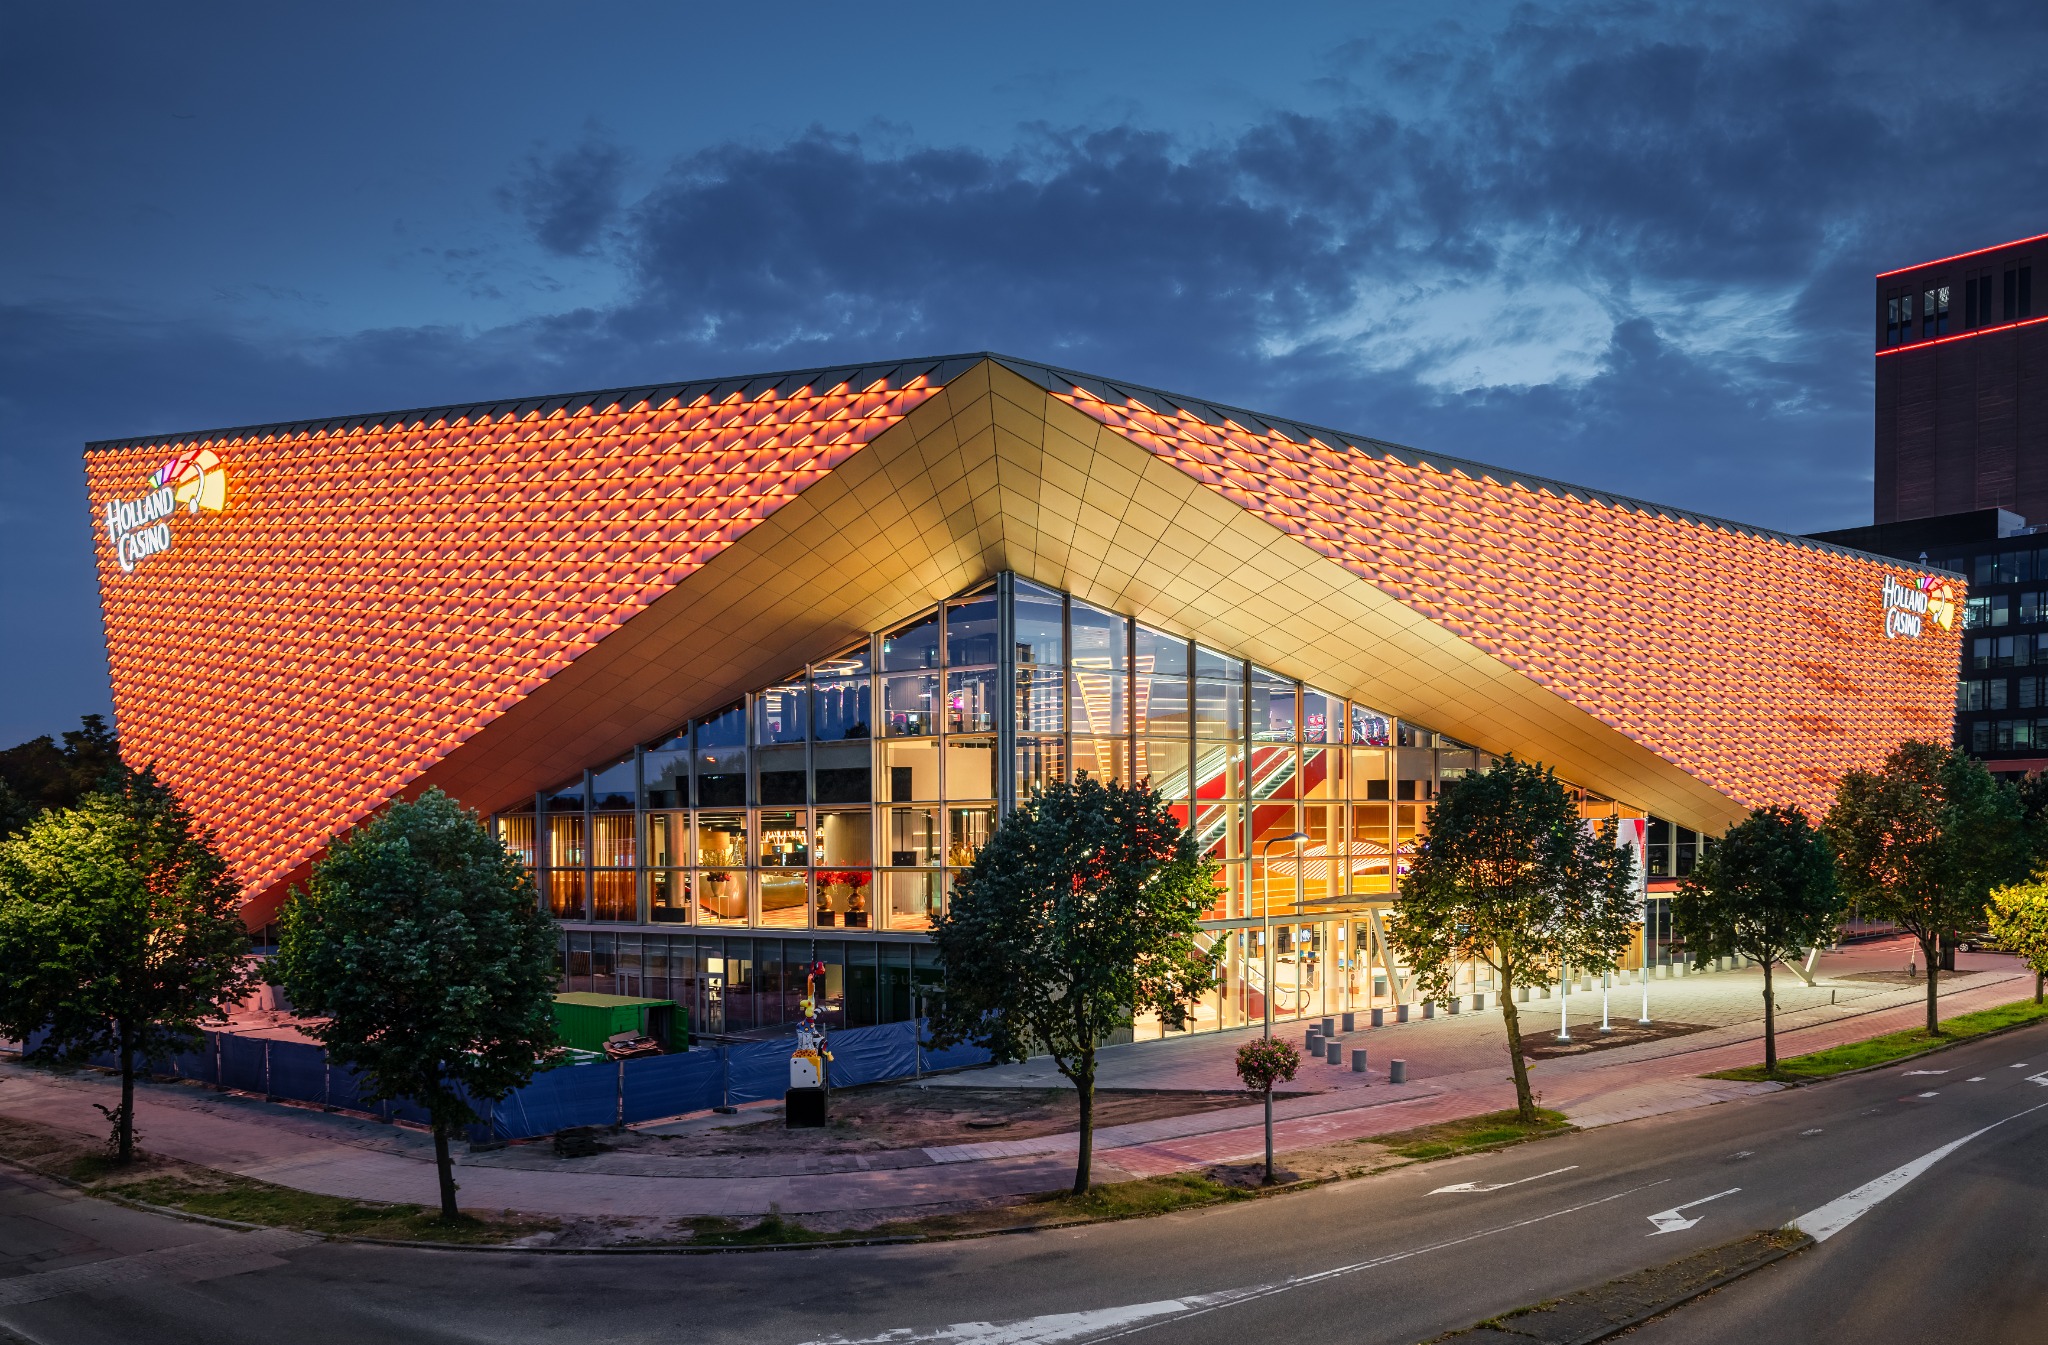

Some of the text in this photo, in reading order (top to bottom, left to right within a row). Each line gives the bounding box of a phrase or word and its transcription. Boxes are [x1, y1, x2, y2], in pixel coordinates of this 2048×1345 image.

[105, 487, 174, 544] HOLLAND
[118, 523, 170, 572] CASINO
[1882, 574, 1928, 614] HOLLAND
[1886, 607, 1921, 638] CASINO
